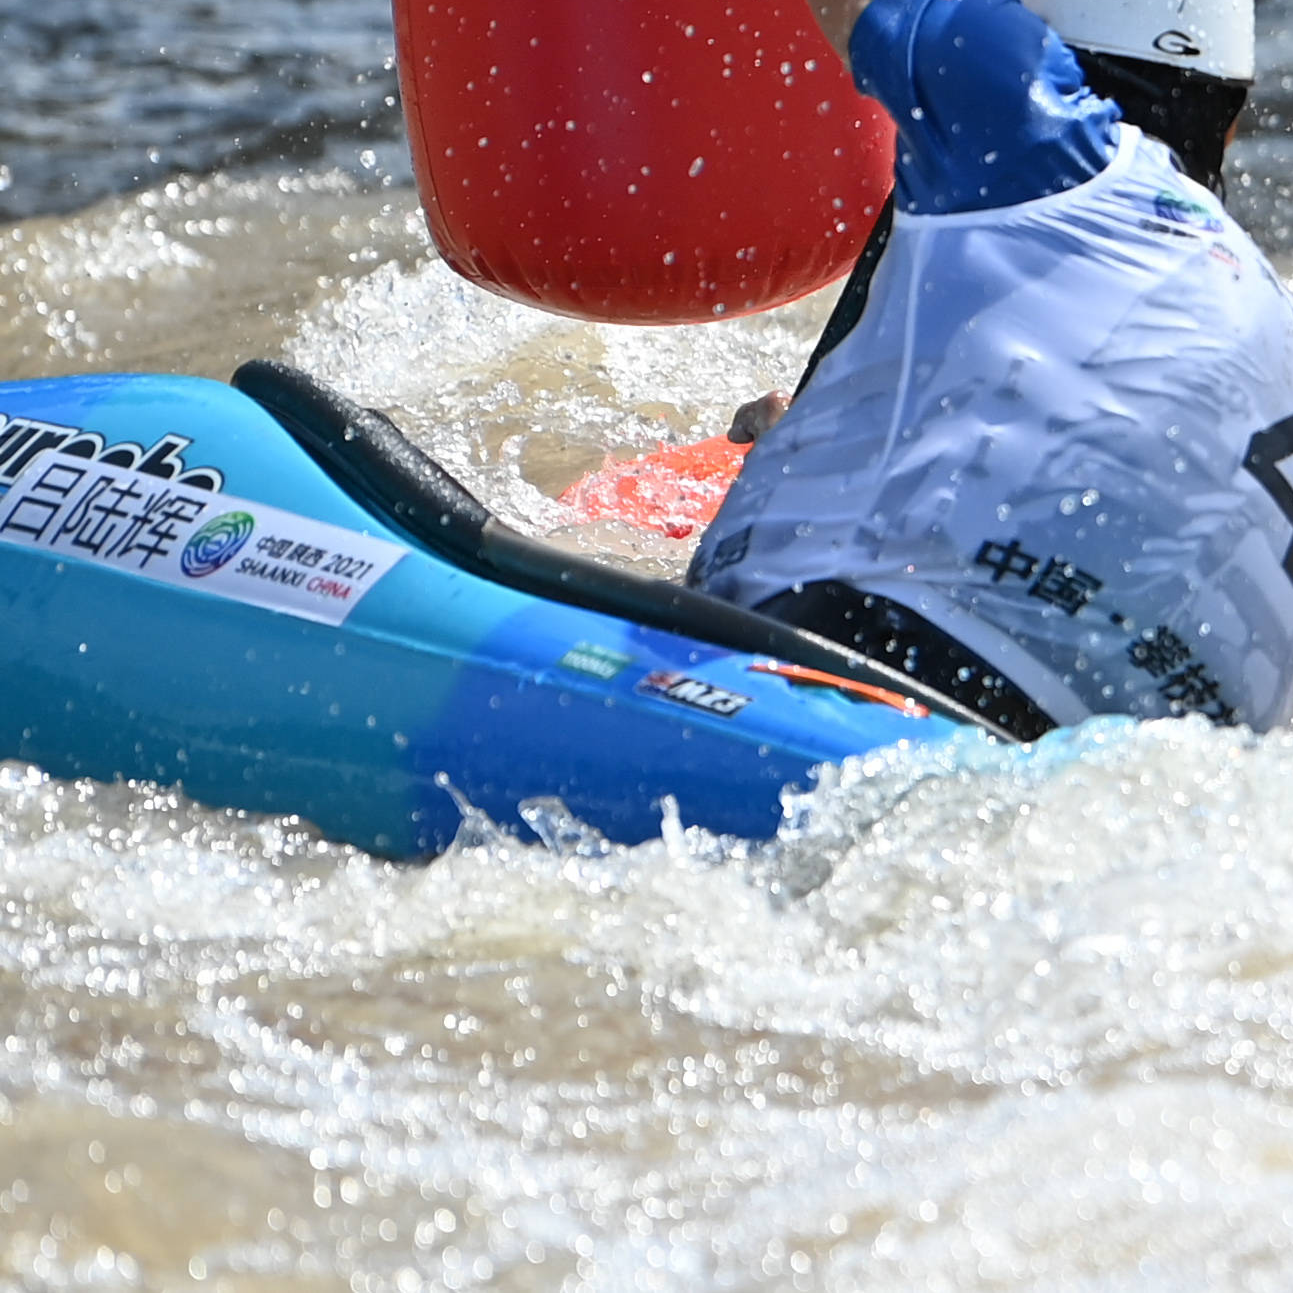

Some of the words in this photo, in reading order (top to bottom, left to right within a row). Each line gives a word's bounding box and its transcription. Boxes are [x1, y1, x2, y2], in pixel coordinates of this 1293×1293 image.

[234, 557, 307, 589] SHAANXI
[306, 576, 350, 600] CHINA
[320, 553, 374, 581] 2021
